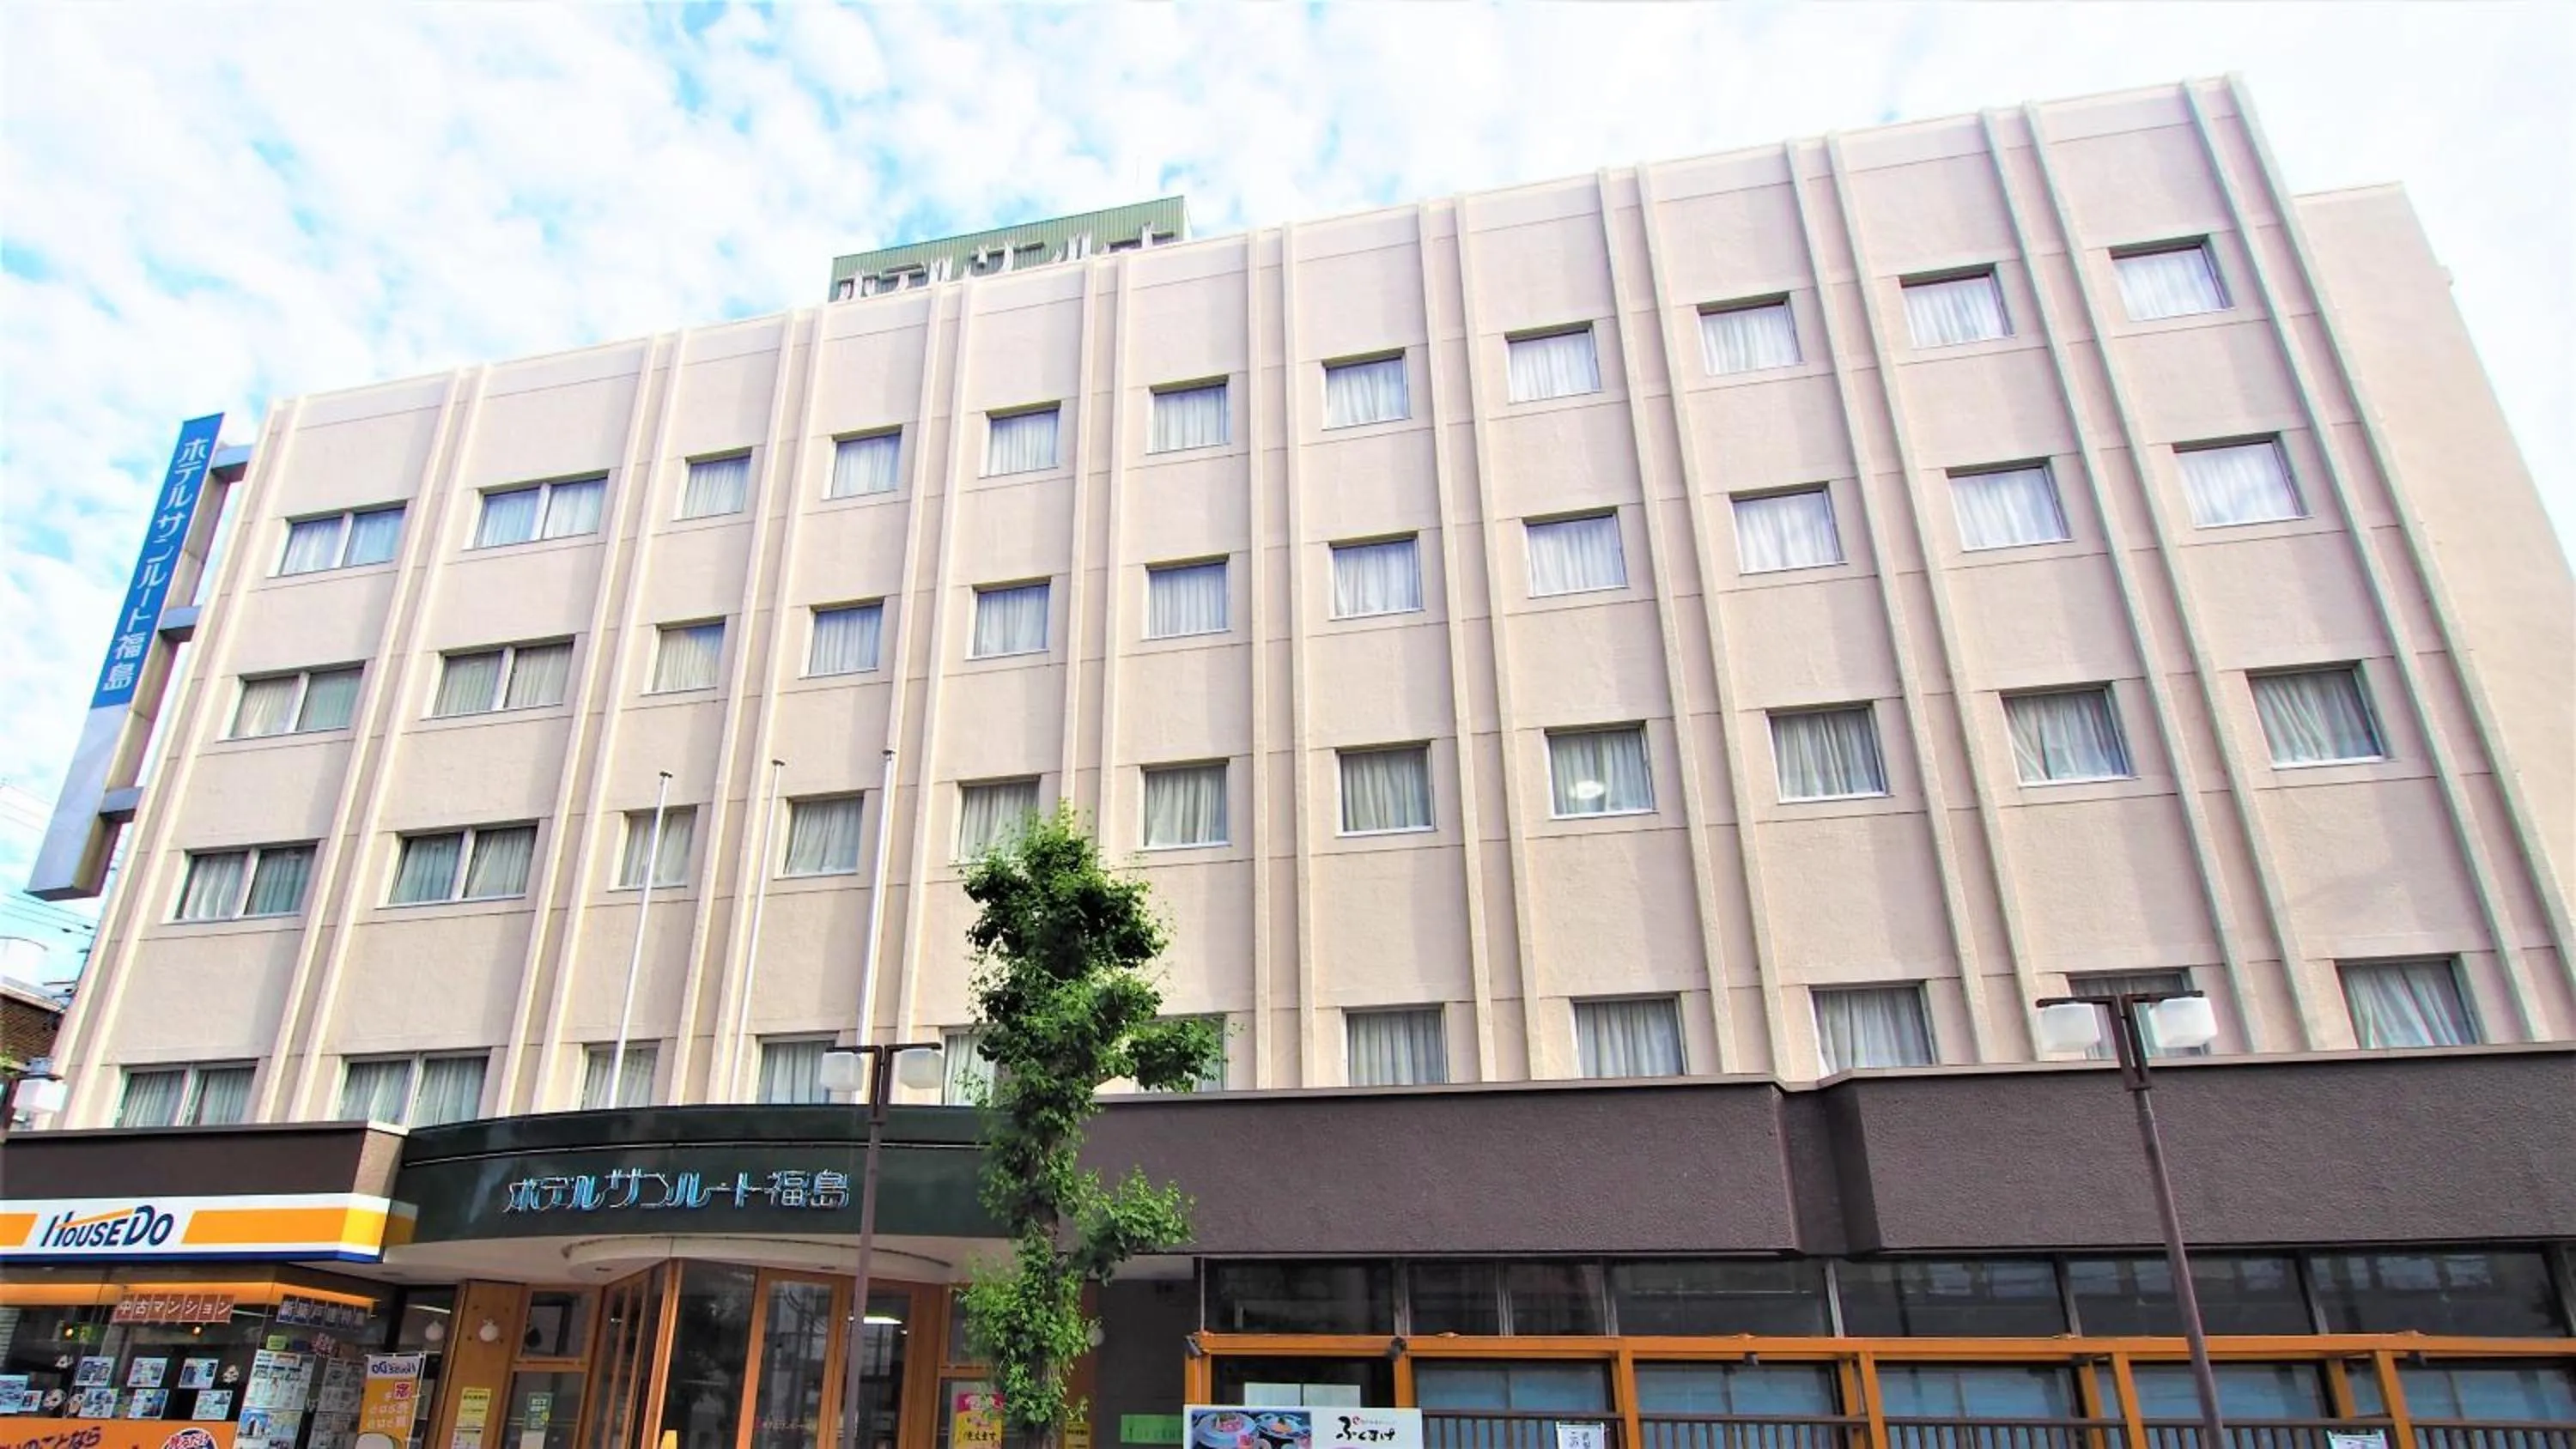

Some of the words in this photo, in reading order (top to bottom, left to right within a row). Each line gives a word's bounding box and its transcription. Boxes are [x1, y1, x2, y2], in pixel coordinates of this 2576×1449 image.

[101, 436, 210, 691] ホテルサンルート福島
[503, 1168, 850, 1213] ホテルサンルート福島
[119, 1298, 232, 1315] 中古マンション
